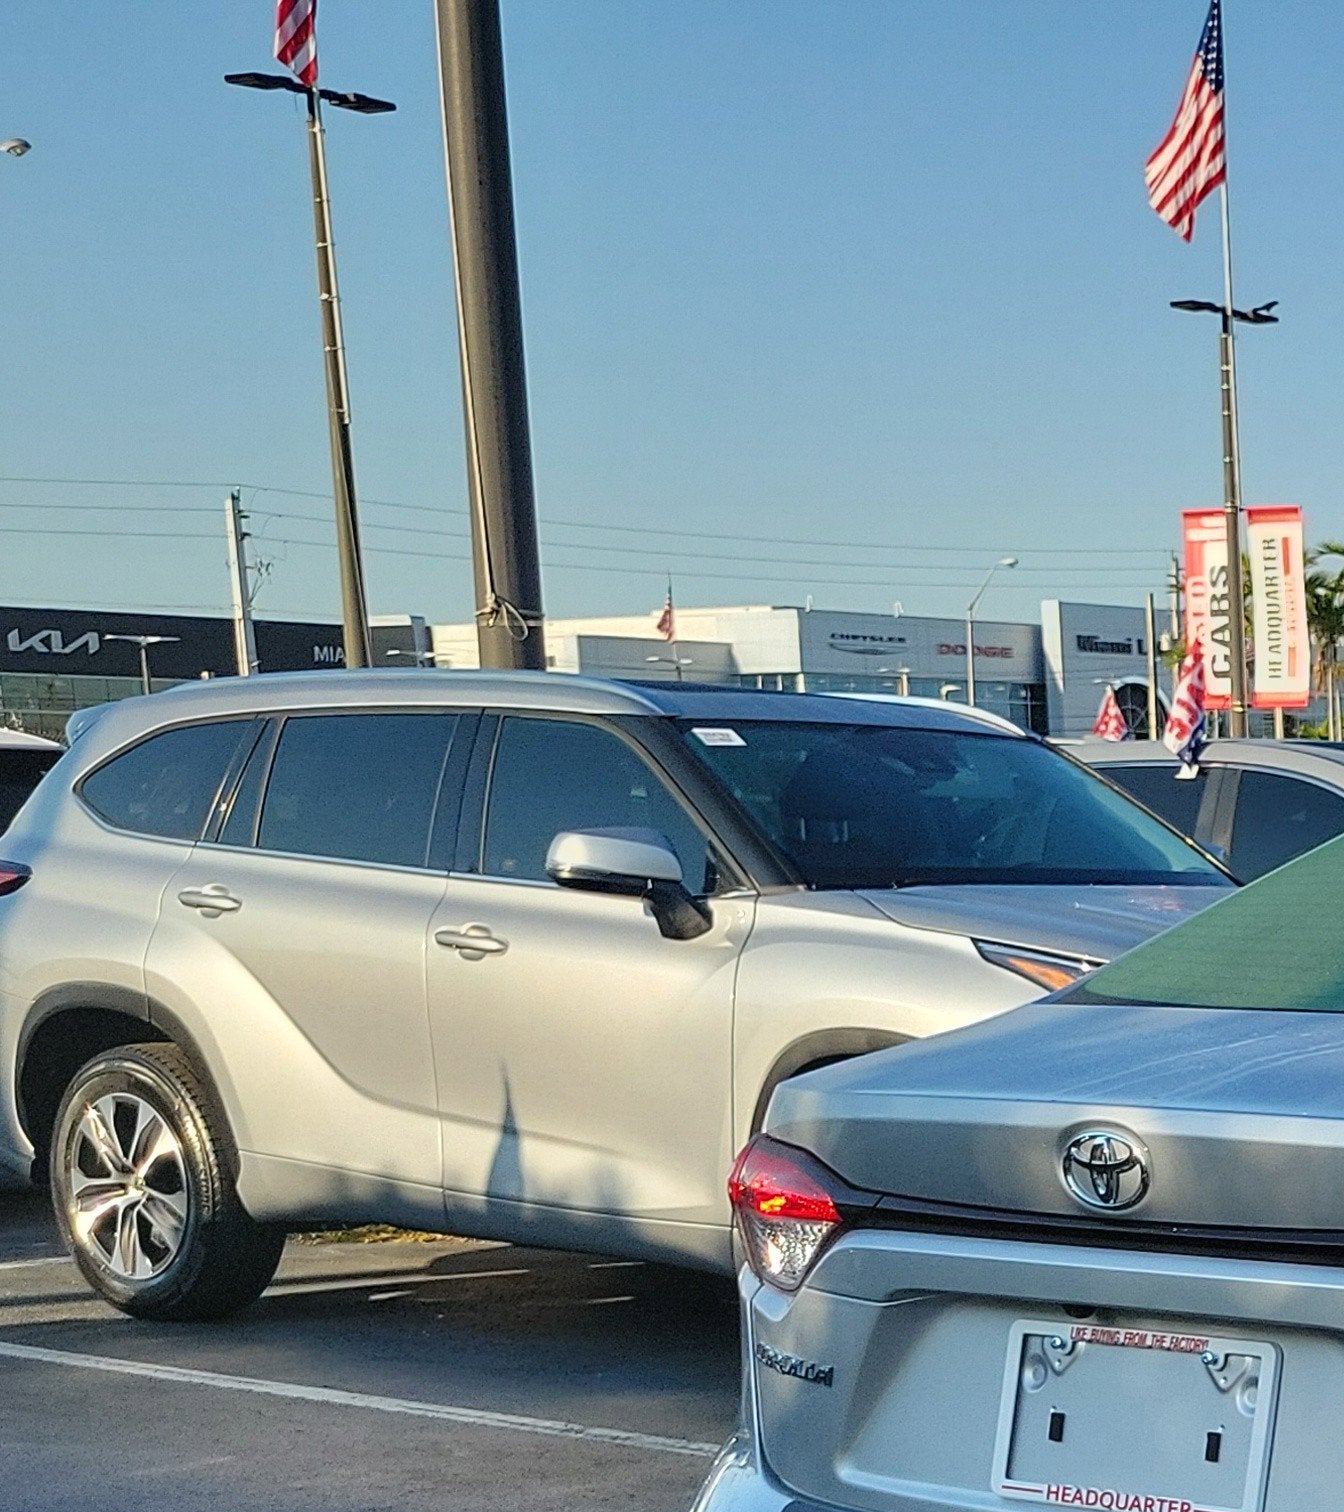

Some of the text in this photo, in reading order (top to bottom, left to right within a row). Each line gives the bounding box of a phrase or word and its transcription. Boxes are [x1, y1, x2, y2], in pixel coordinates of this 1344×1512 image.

[6, 627, 101, 655] KIA
[1210, 565, 1232, 679] CARS
[1262, 537, 1284, 679] HEADQUARTER
[1070, 1326, 1088, 1341] LIKE
[1123, 1332, 1148, 1348] FROM
[1150, 1334, 1167, 1349] THE
